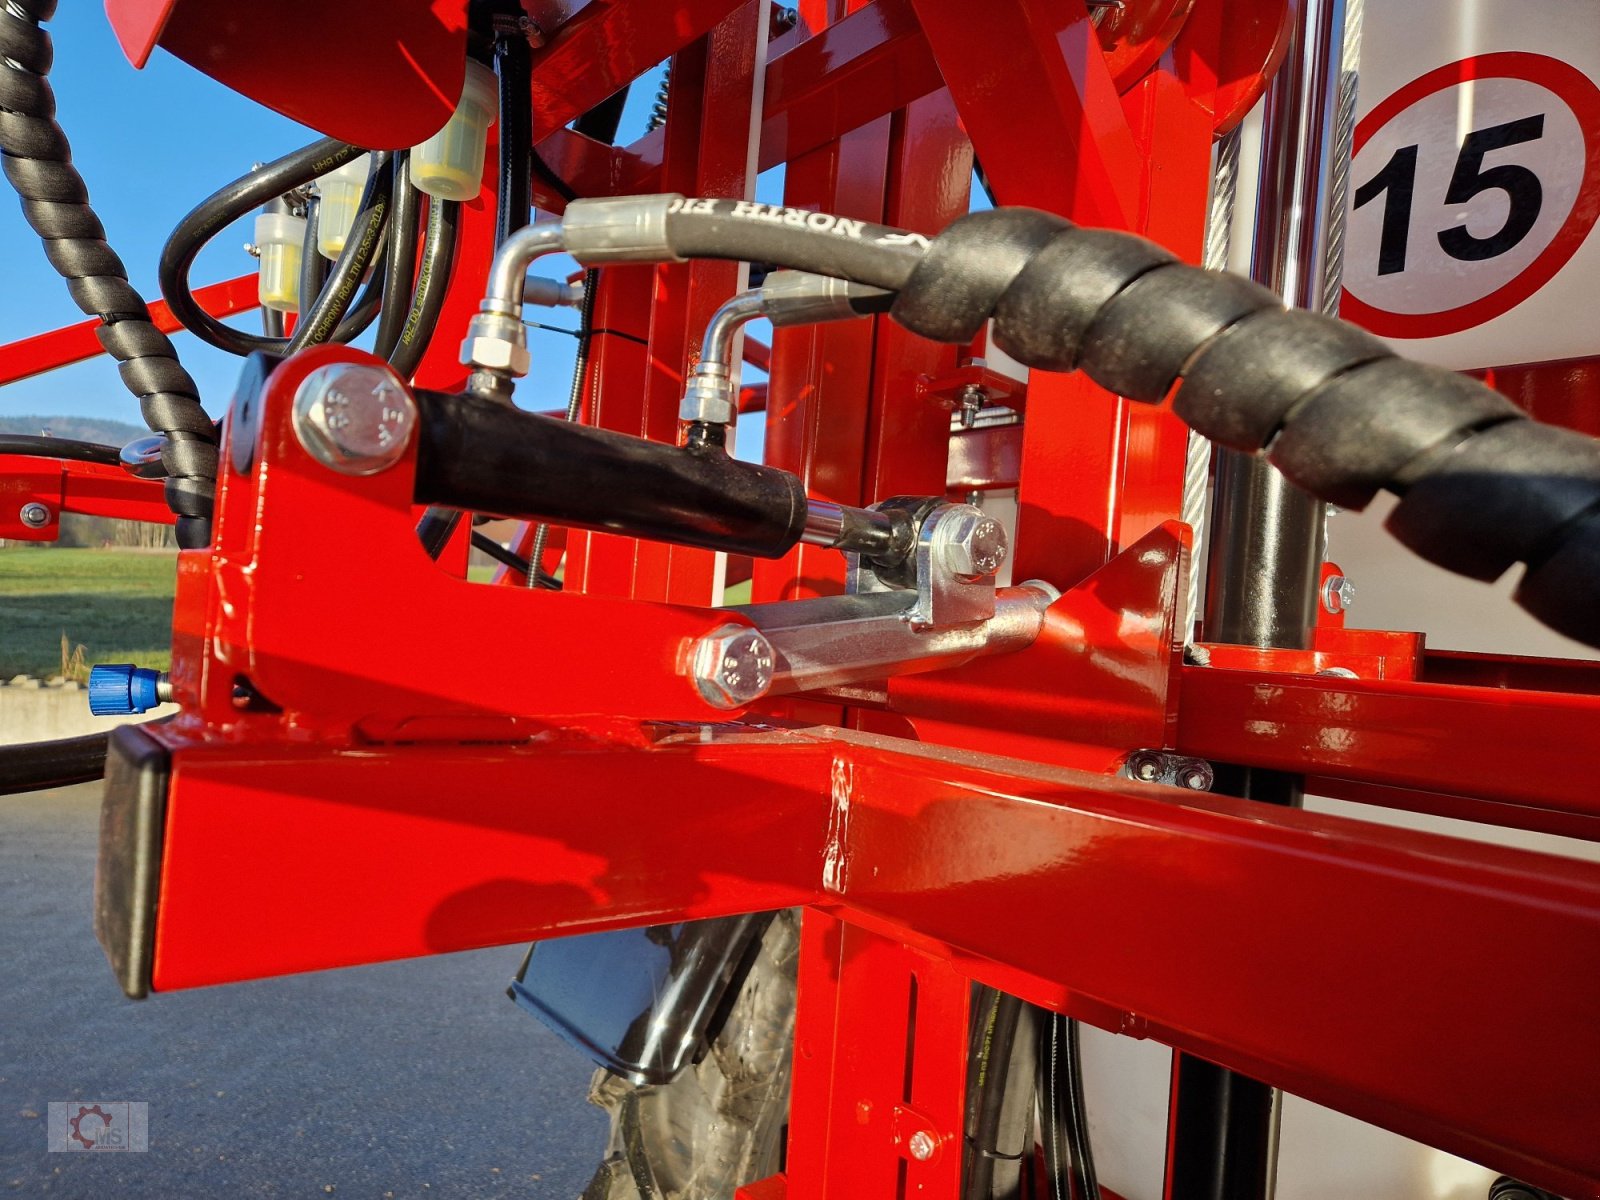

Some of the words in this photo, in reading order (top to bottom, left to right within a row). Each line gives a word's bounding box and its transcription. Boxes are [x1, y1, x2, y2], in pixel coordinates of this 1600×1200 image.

[1353, 113, 1545, 276] 15
[731, 200, 867, 239] NORTH
[315, 299, 341, 342] OCHRONY
[410, 308, 420, 324] DO
